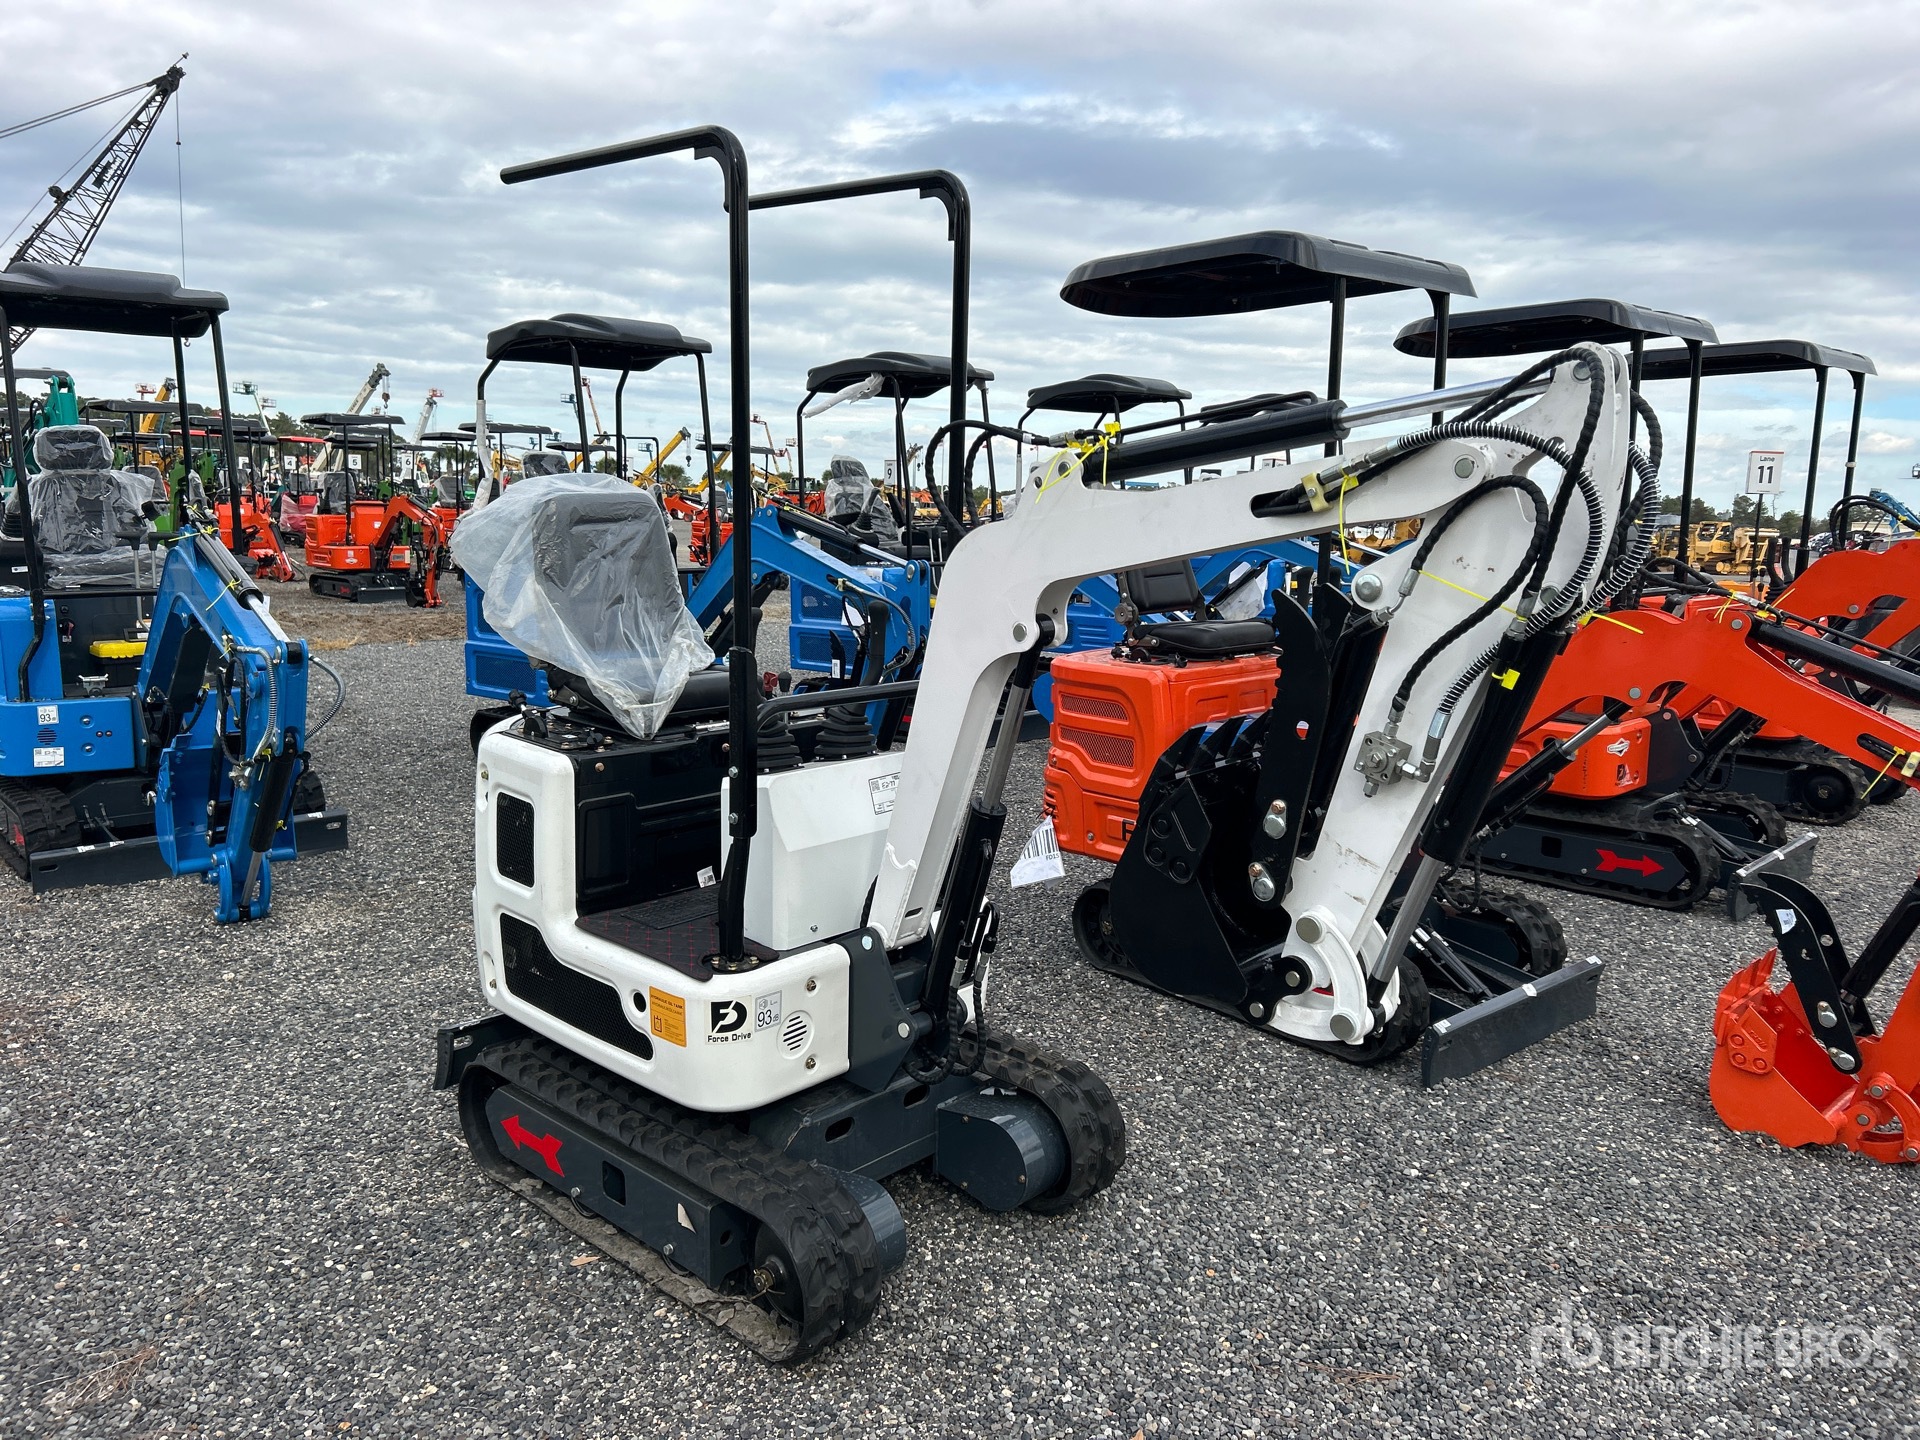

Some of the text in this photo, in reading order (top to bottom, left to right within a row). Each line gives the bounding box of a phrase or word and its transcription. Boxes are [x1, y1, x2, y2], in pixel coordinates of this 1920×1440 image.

[352, 458, 358, 466] 5
[405, 458, 411, 466] 6
[887, 468, 893, 479] 9
[1758, 466, 1774, 483] 11
[39, 713, 52, 722] 93
[757, 1009, 772, 1028] 93
[707, 1032, 752, 1043] Force Drive
